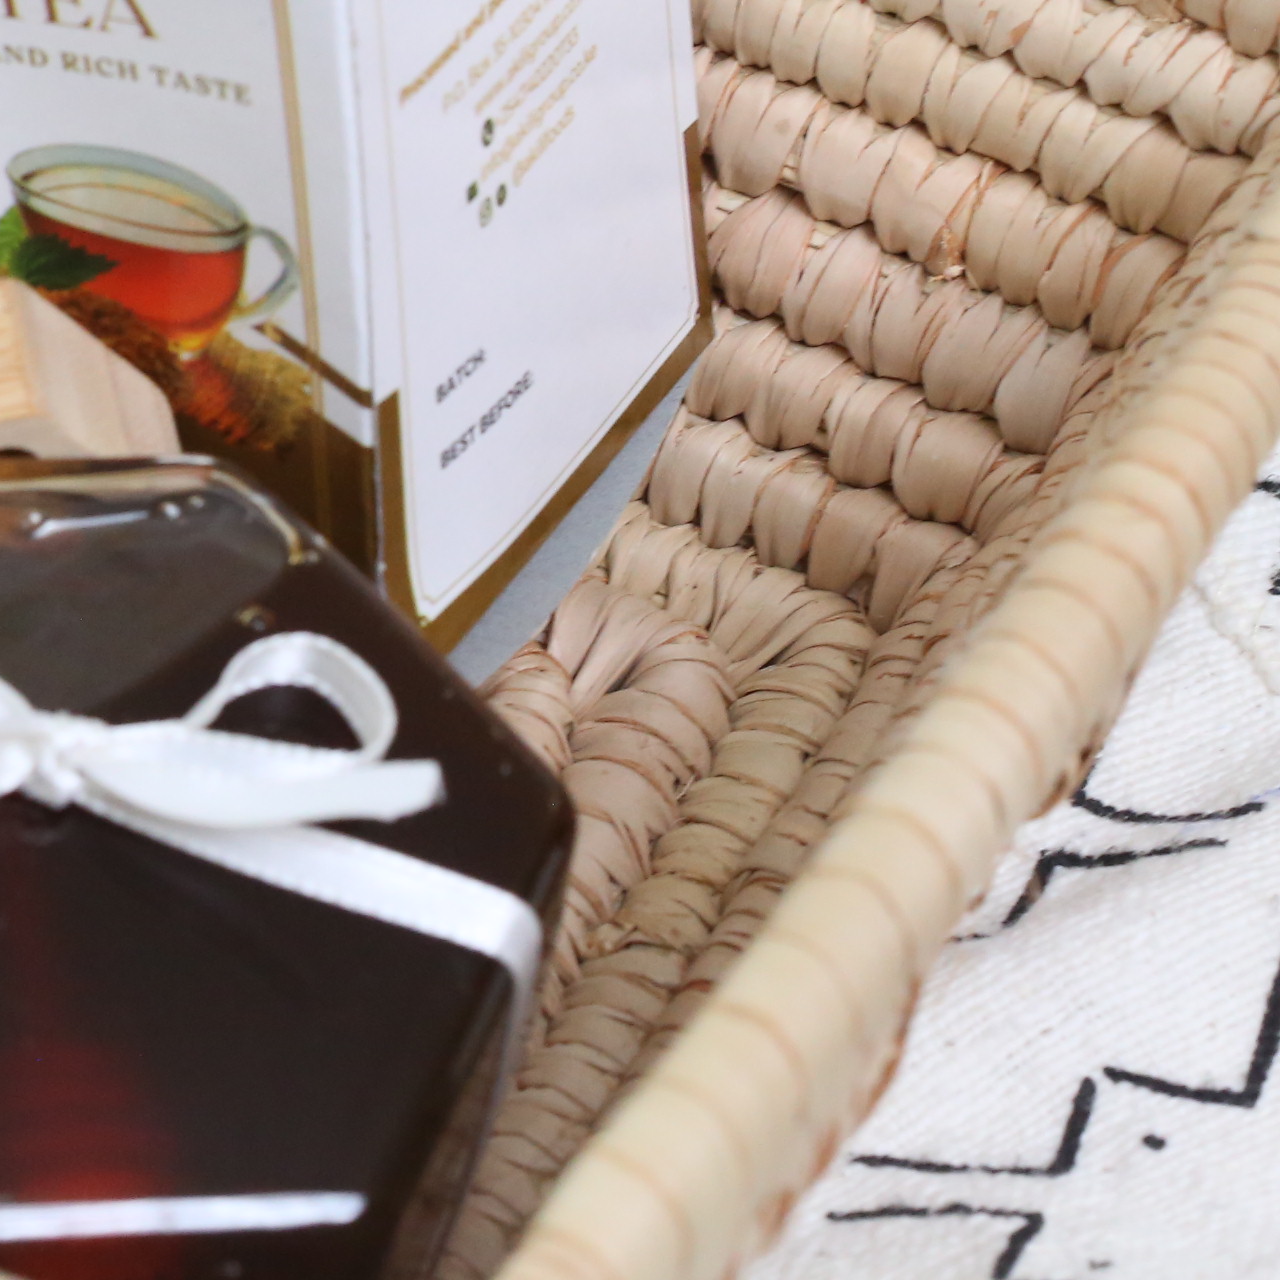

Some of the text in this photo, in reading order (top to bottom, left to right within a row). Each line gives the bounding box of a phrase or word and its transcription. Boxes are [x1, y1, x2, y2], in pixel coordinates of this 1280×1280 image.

[60, 49, 139, 83] RICH
[149, 64, 254, 107] TASTE
[439, 424, 477, 470] BEST
